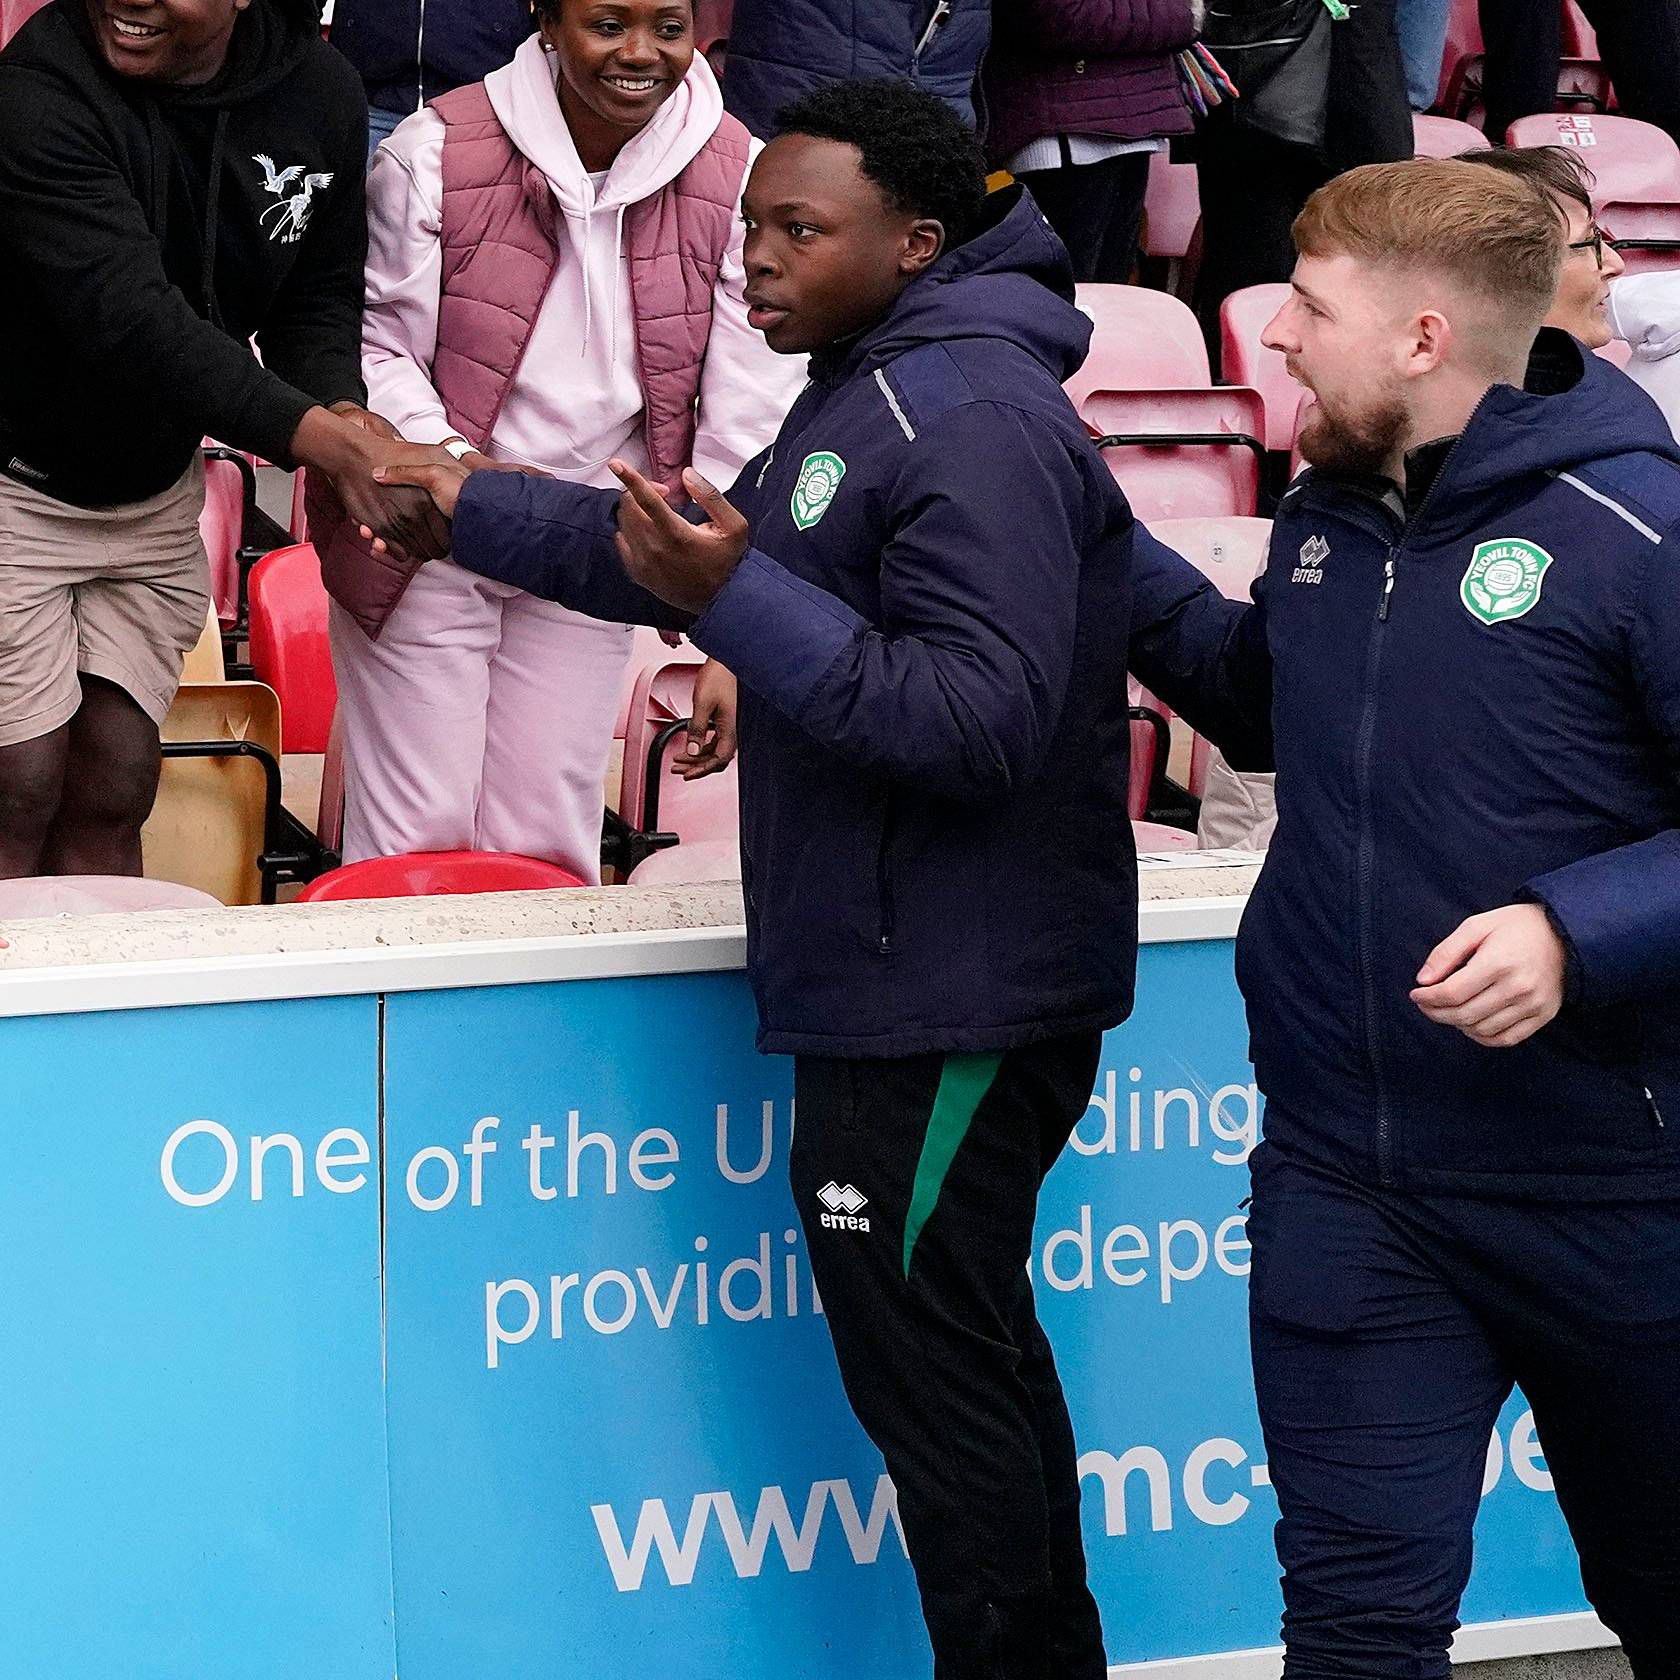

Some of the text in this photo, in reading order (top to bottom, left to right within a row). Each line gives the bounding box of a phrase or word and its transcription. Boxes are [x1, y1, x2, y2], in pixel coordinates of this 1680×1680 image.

[1291, 567, 1323, 585] errea
[1471, 546, 1510, 580] YEOVIL
[1510, 546, 1539, 574] TOWN
[160, 1119, 371, 1207] One
[406, 1117, 501, 1212] of
[522, 1110, 680, 1201] the
[716, 1098, 795, 1184] U
[820, 1213, 870, 1232] errea
[486, 1228, 824, 1369] providi
